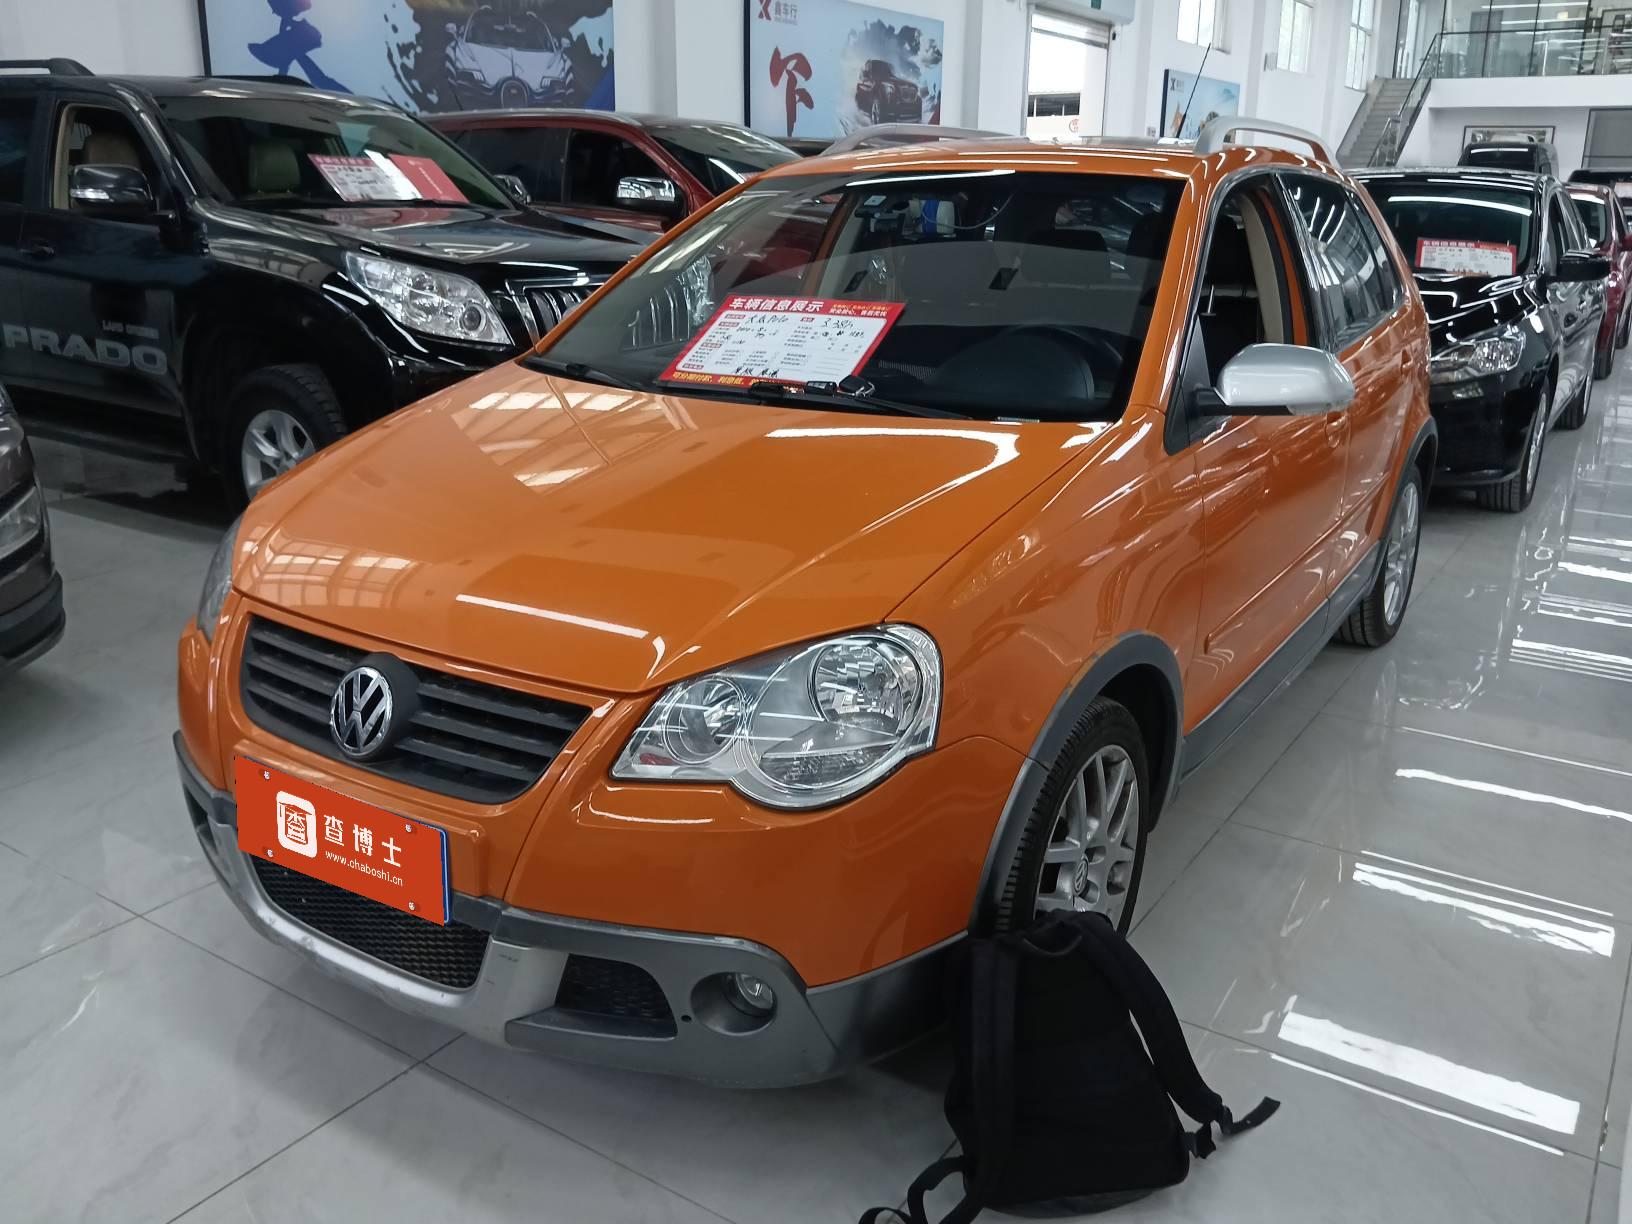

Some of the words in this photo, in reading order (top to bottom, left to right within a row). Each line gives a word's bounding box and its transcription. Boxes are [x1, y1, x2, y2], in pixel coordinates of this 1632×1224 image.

[729, 298, 825, 314] 车辆信息展示
[2, 323, 168, 375] PRADO
